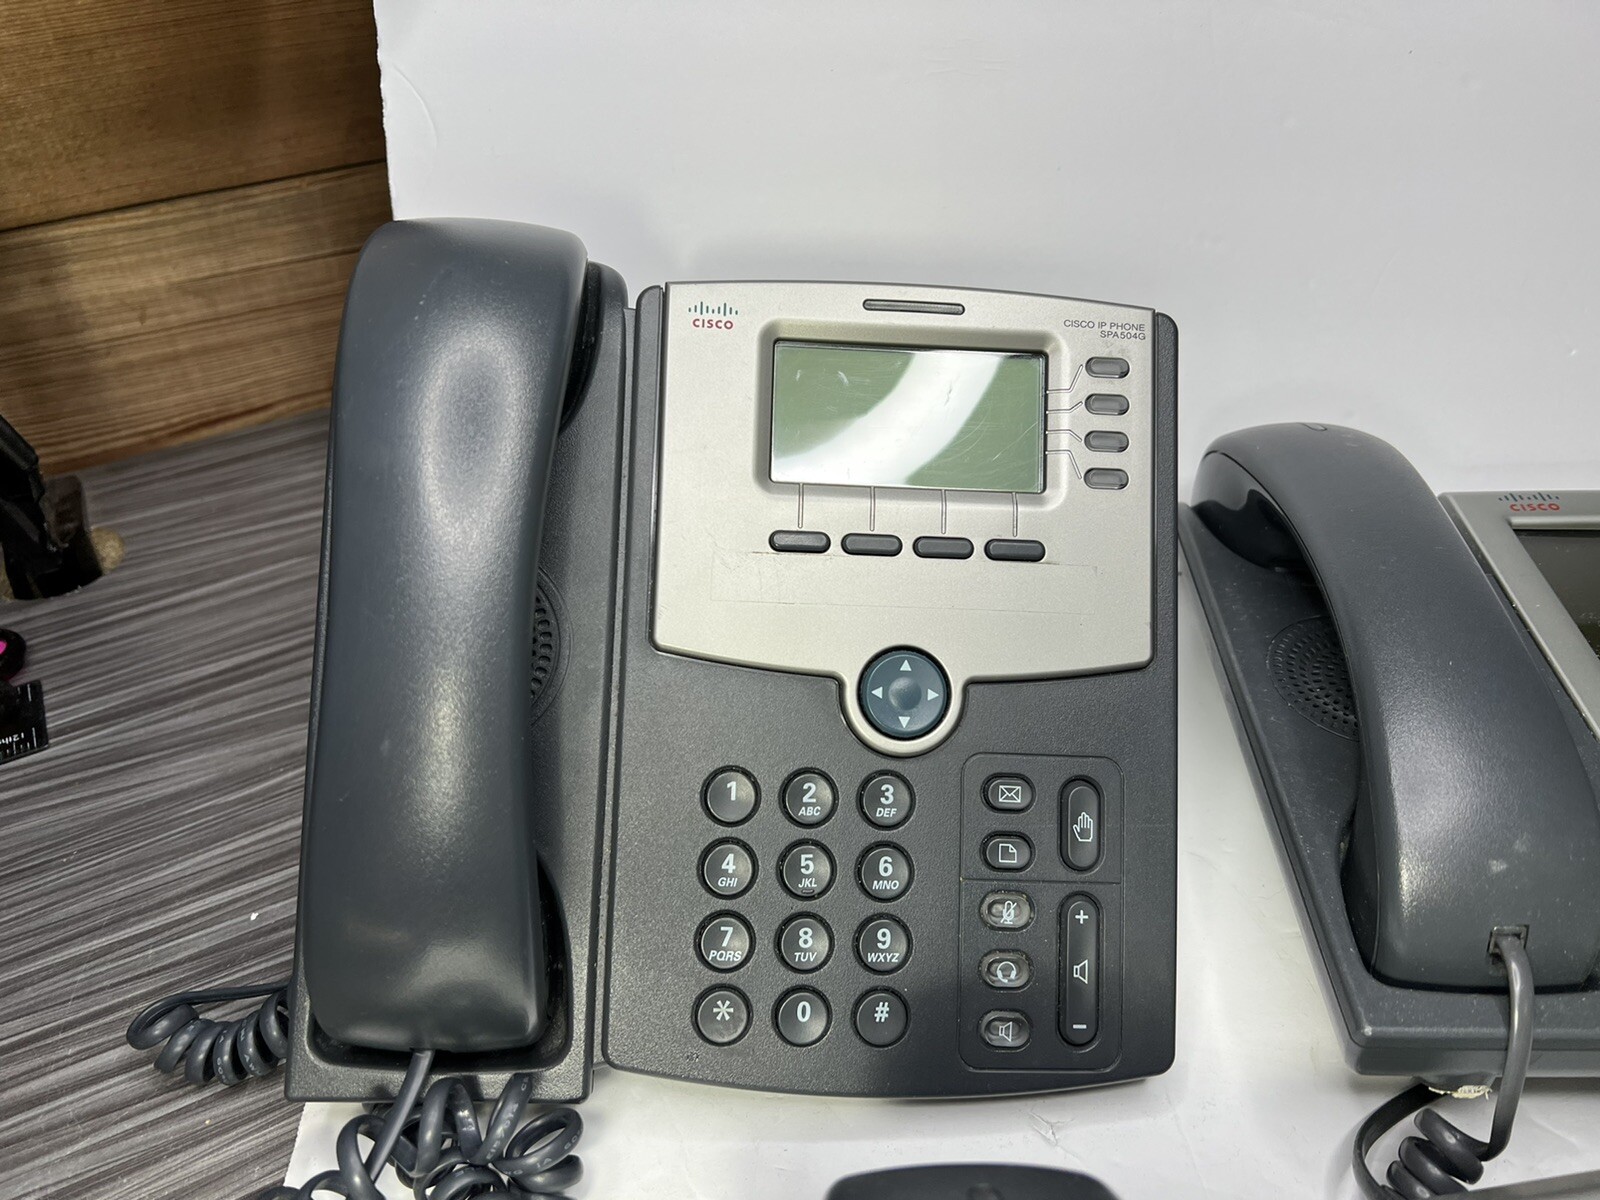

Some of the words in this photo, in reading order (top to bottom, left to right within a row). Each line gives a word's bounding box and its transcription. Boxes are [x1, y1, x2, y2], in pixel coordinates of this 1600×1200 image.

[692, 318, 734, 330] CISCO
[1063, 319, 1096, 329] CISCO
[1097, 321, 1107, 330] IP
[1109, 322, 1146, 332] PHONE
[1100, 330, 1146, 341] SPA504G
[1509, 502, 1560, 512] CISCO
[727, 781, 737, 801] 1
[802, 782, 816, 803] 2
[880, 784, 894, 804] 3
[798, 806, 821, 816] ABC
[876, 808, 897, 818] DEF
[721, 853, 736, 874] 4
[800, 854, 815, 875] 5
[878, 856, 893, 877] 6
[717, 877, 738, 887] GHI
[798, 877, 818, 888] JKL
[872, 880, 900, 890] MNO
[720, 926, 734, 947] 7
[799, 927, 813, 949] 8
[876, 928, 892, 949] 9
[708, 950, 742, 962] PQRS
[793, 952, 818, 962] TUV
[867, 952, 900, 963] WXYZ
[796, 1001, 811, 1022] 0
[873, 1001, 890, 1023] #
